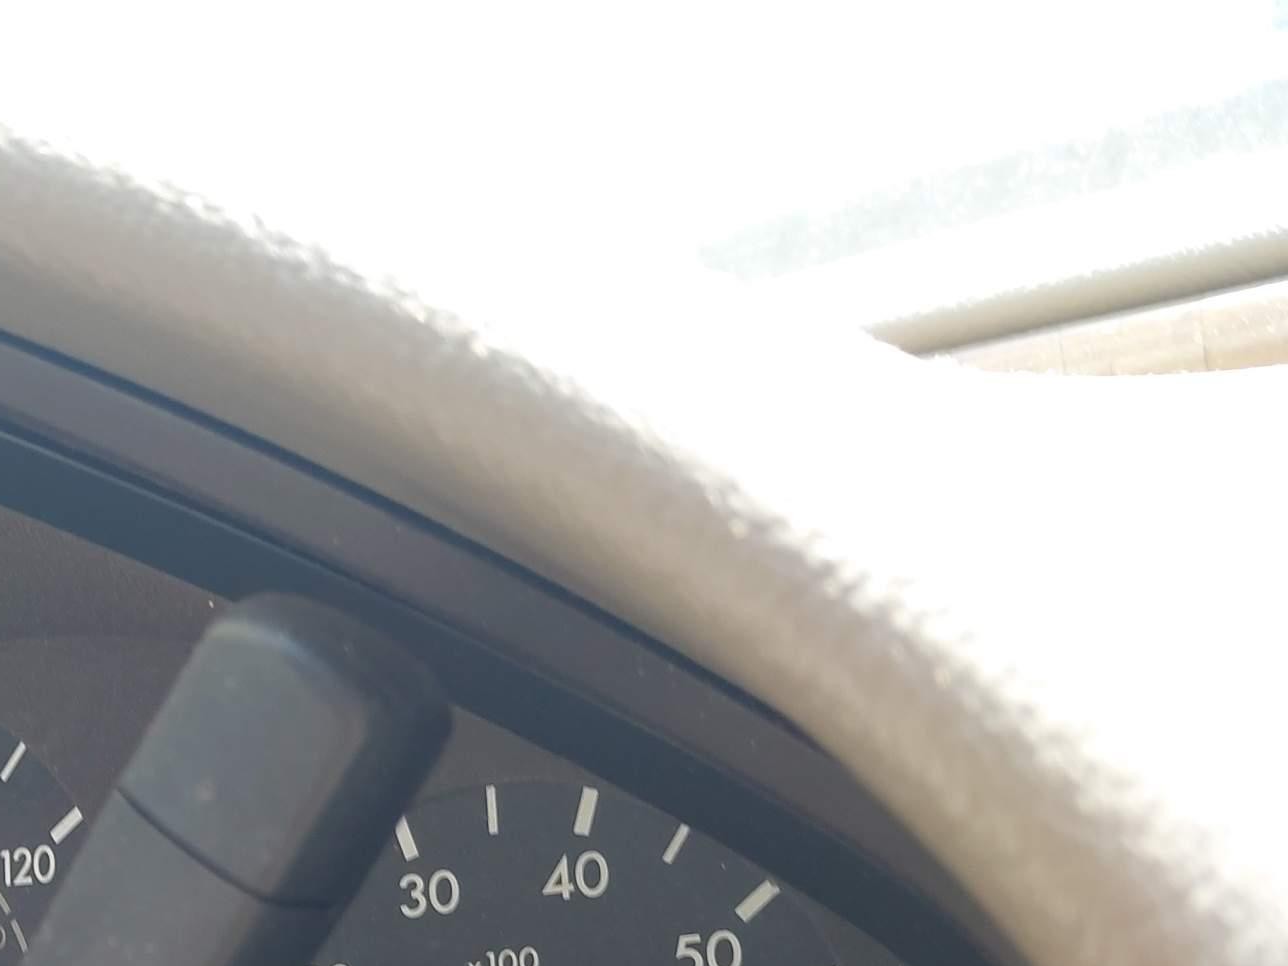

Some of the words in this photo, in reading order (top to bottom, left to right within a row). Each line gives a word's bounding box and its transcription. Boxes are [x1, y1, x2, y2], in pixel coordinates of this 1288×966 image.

[1, 844, 55, 886] 120
[542, 850, 609, 900] 40
[399, 869, 460, 918] 30
